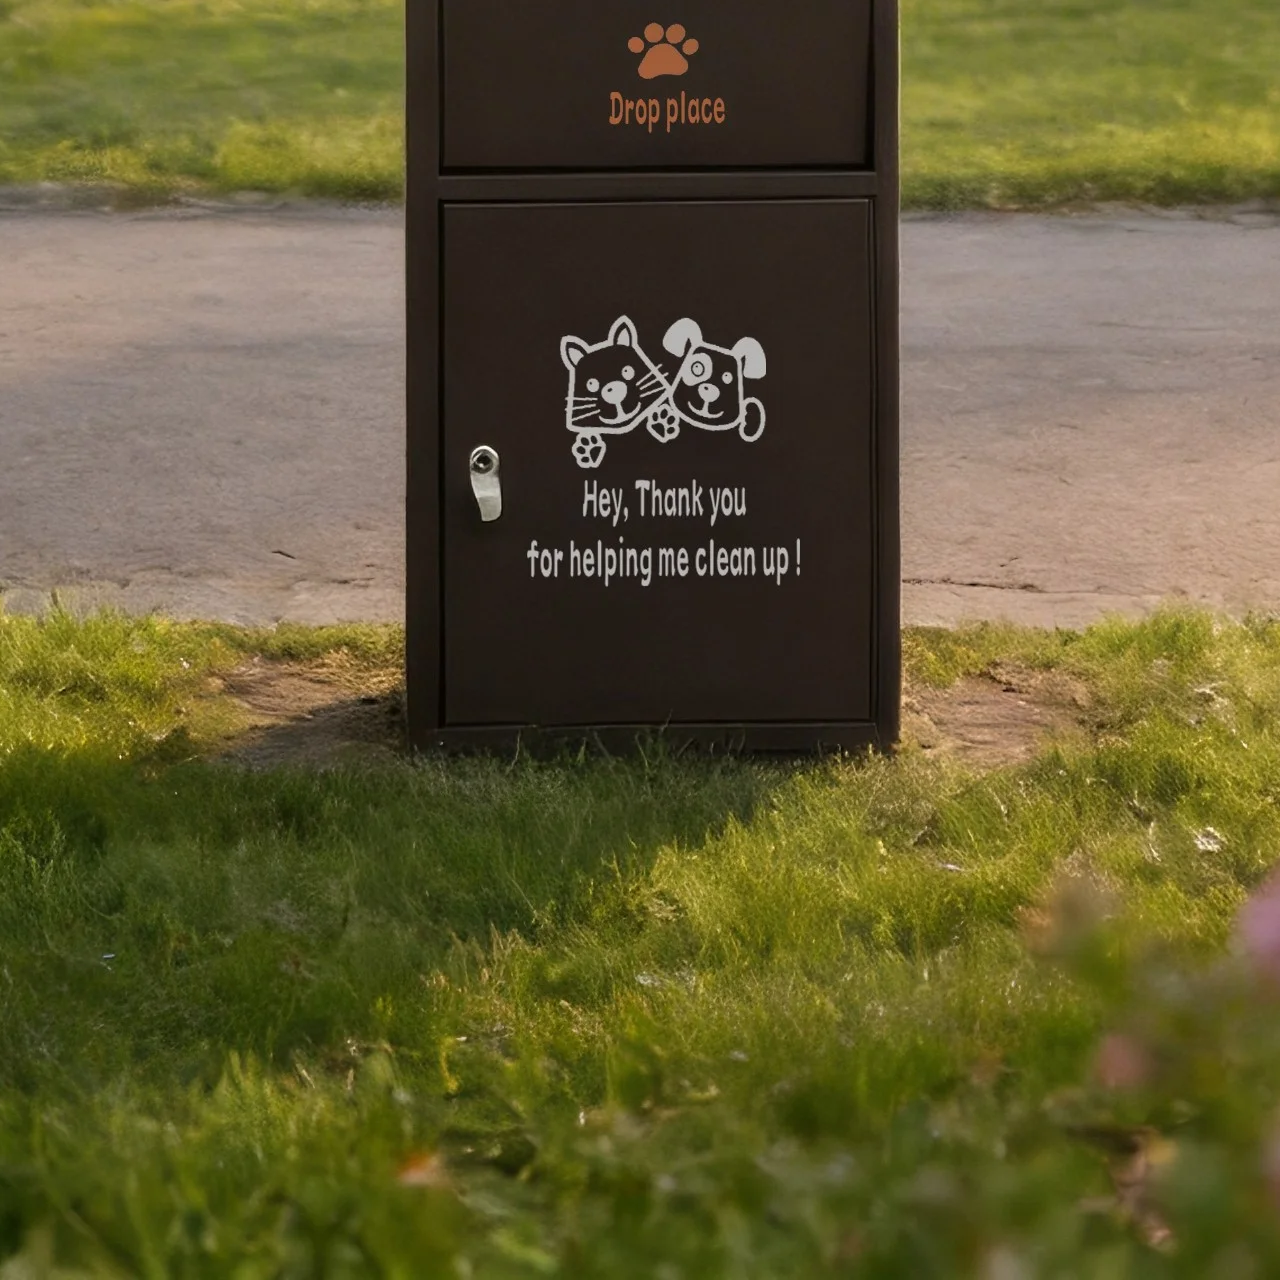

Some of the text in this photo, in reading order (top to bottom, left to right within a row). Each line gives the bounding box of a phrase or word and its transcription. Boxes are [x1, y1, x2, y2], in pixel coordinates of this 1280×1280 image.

[609, 91, 726, 134] Drop place
[583, 478, 747, 527] Hey, Thank you
[527, 540, 564, 578] for
[570, 536, 653, 587] helping
[658, 547, 690, 577] me
[695, 538, 757, 577] clean
